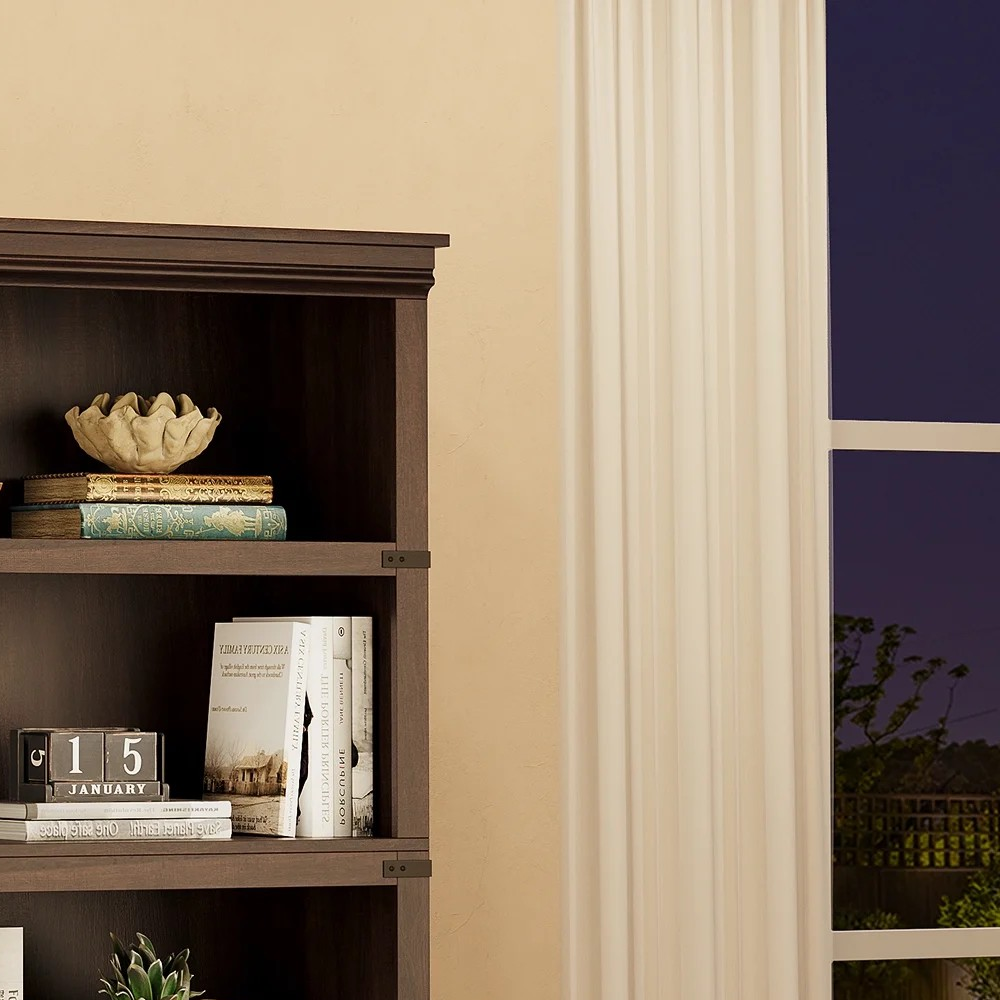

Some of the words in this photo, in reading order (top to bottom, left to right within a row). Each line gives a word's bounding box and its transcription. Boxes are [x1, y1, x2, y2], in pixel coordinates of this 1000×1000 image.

[68, 736, 82, 774] 1
[123, 737, 142, 775] 5
[68, 783, 146, 795] JANUARY
